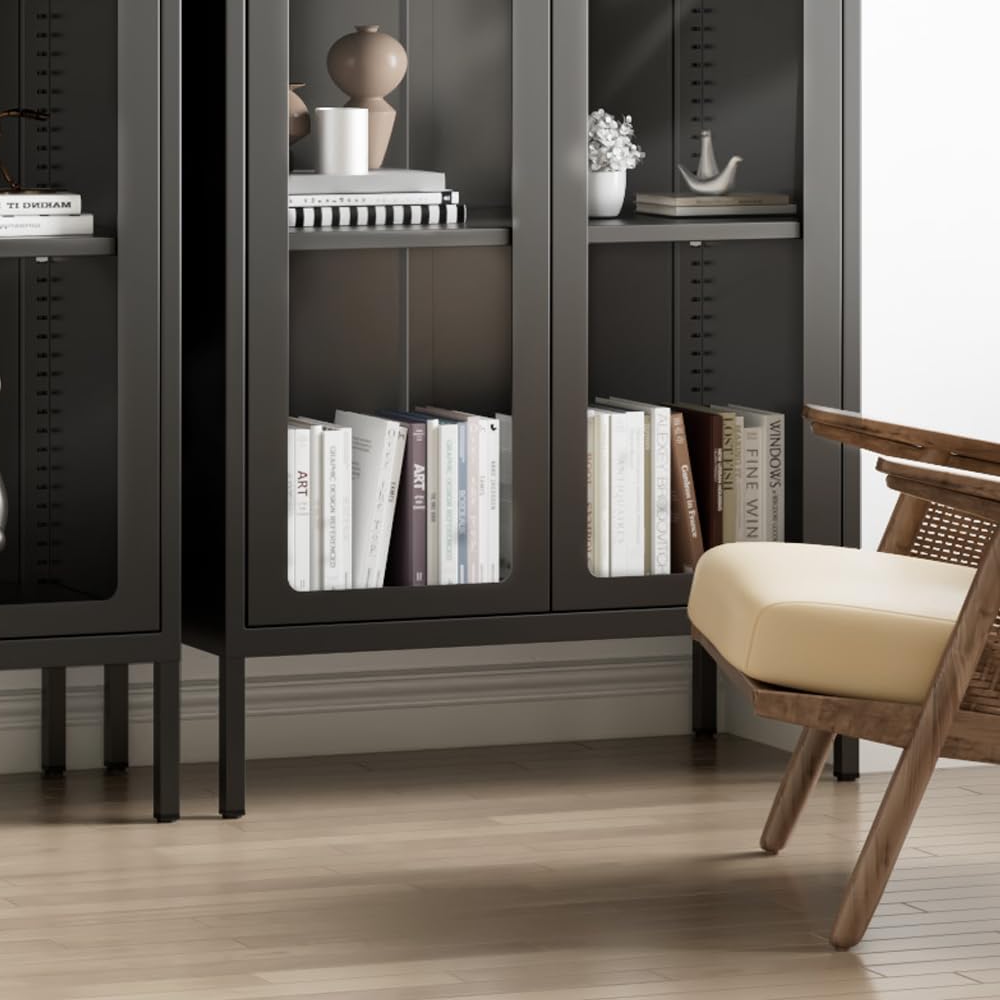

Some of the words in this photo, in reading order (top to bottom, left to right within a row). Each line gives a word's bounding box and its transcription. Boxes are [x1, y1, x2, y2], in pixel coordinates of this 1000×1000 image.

[746, 449, 759, 489] FINE
[769, 419, 782, 488] WINDOWS
[297, 471, 308, 496] ART
[413, 463, 425, 491] ART
[329, 484, 337, 513] DESIGN
[746, 499, 759, 539] WIN
